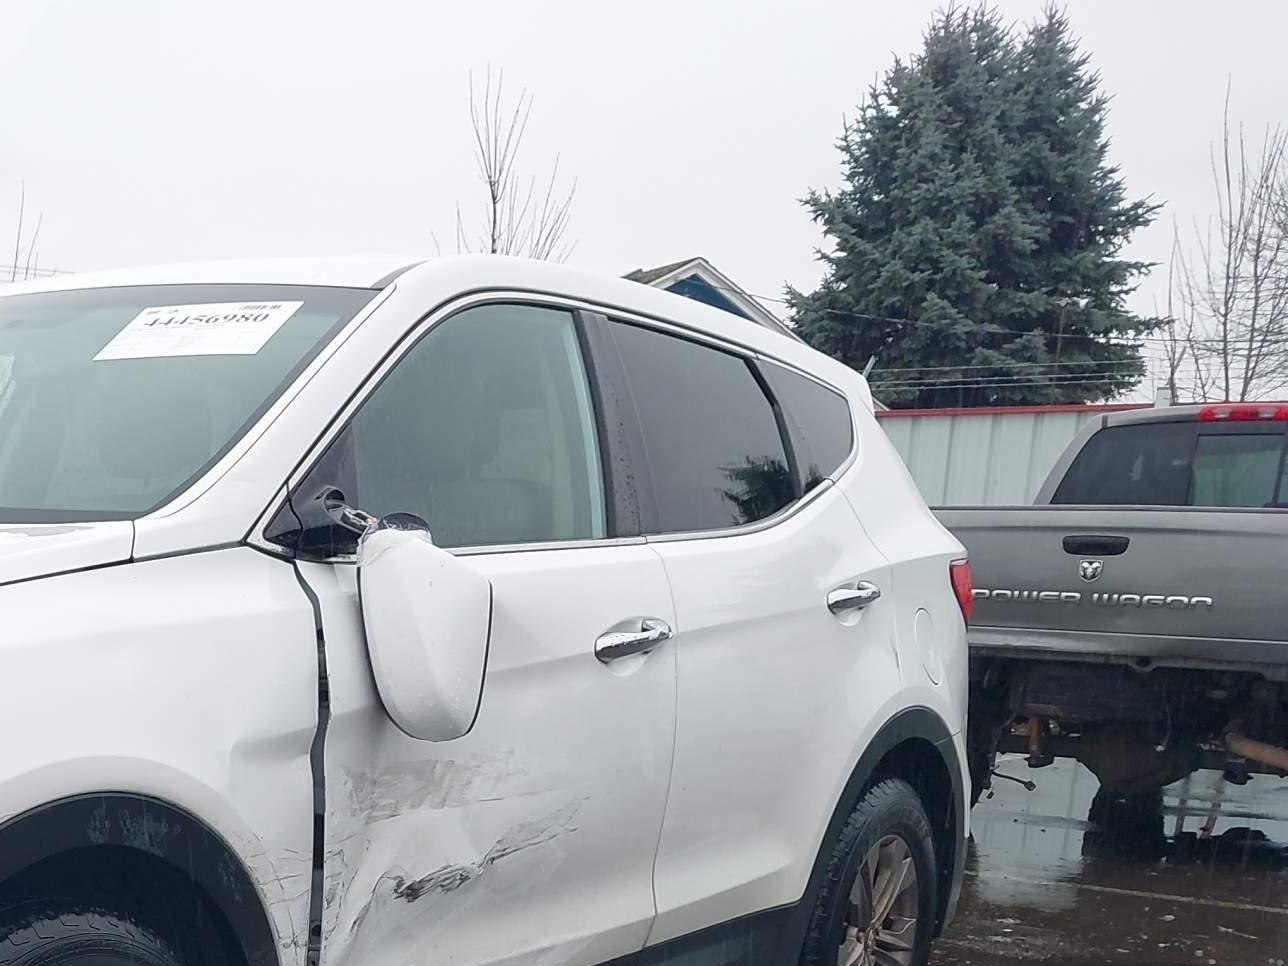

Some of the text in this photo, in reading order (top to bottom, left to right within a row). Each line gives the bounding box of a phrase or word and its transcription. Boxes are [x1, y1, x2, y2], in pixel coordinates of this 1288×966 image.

[143, 313, 270, 327] 44456980
[970, 588, 1213, 609] POWER WAGON
